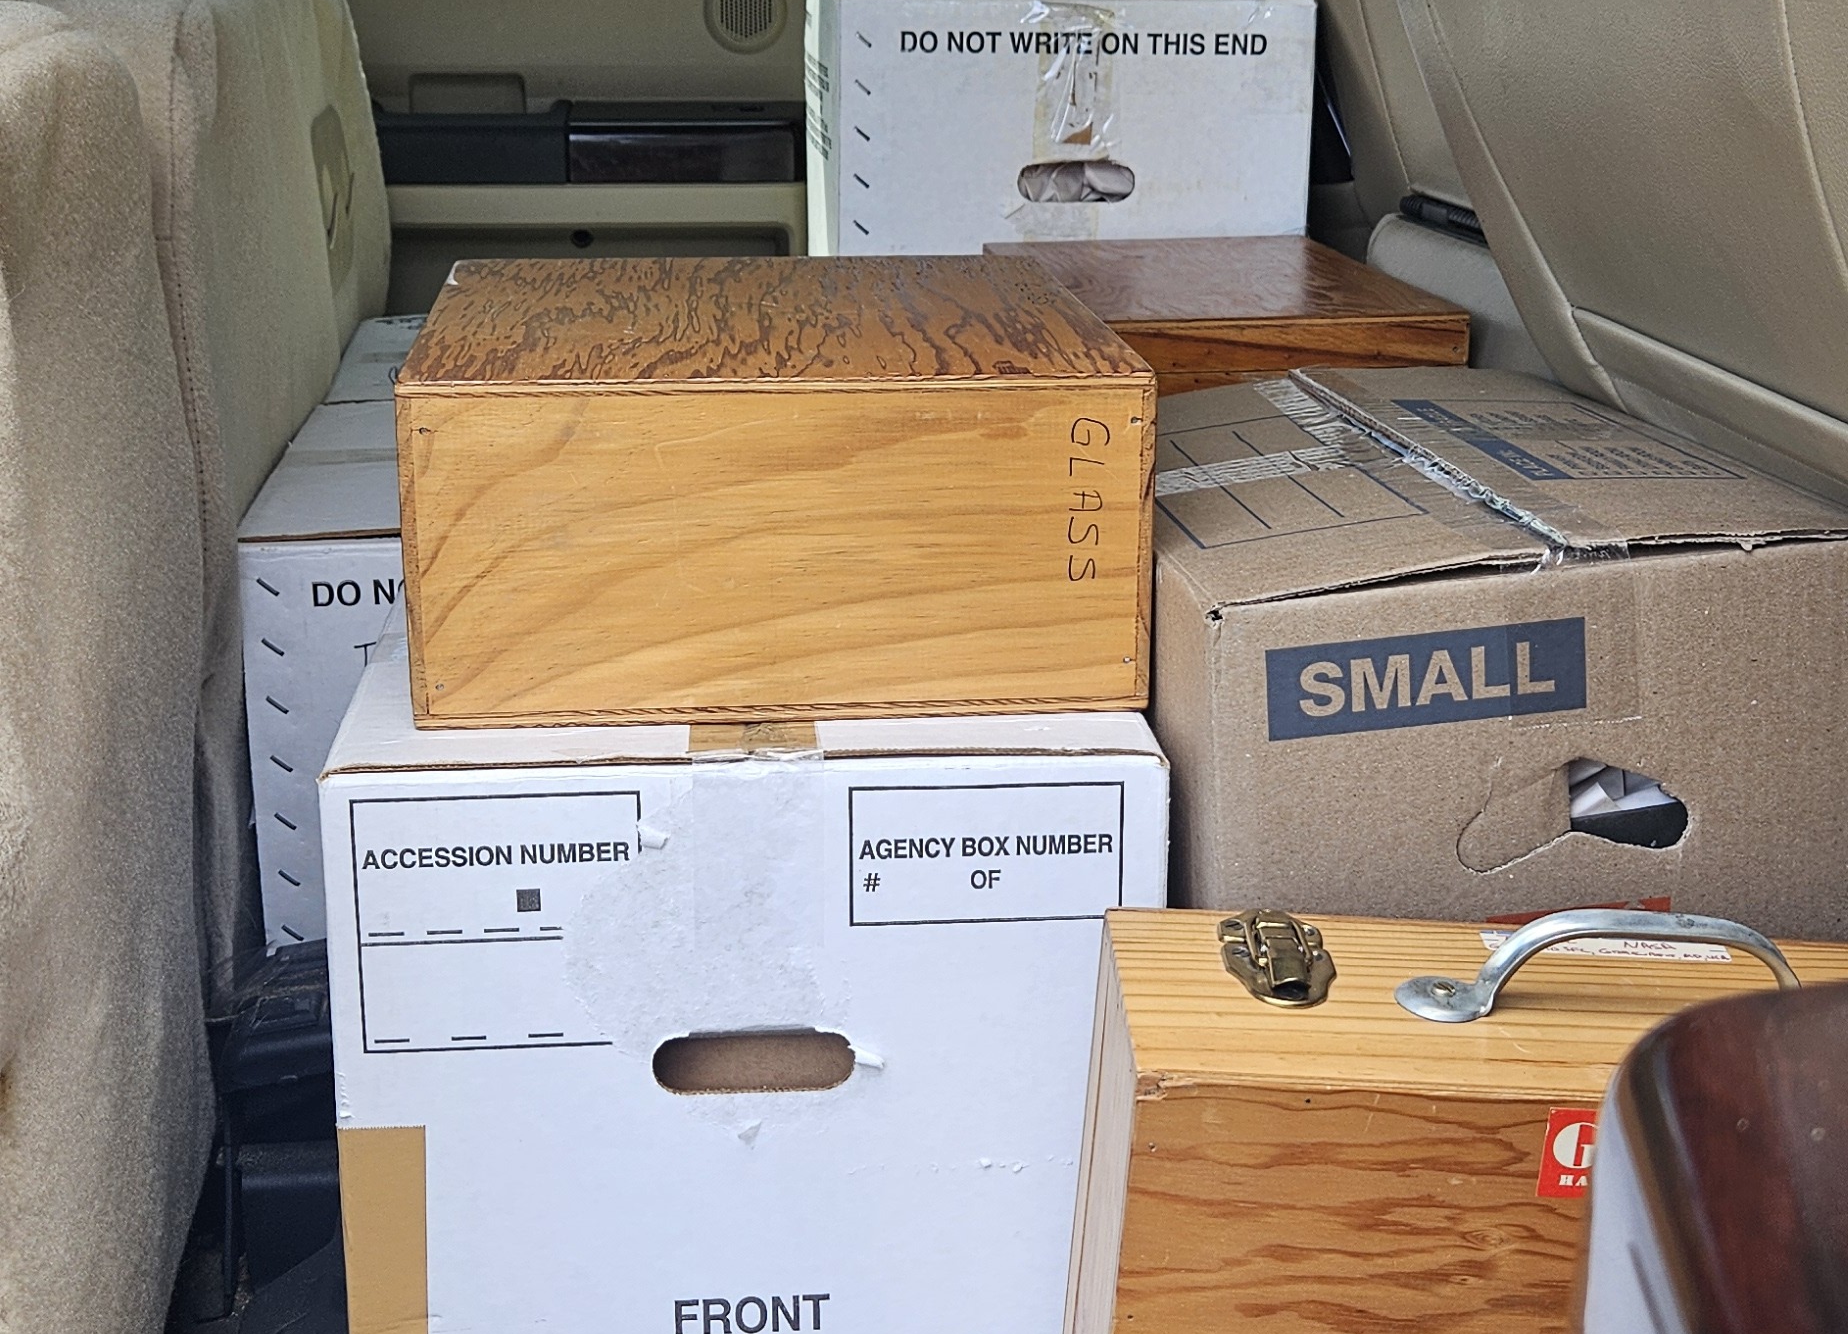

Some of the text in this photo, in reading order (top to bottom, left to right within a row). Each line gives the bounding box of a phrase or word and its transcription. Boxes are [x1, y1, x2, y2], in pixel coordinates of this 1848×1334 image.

[900, 31, 1268, 56] DO NOT WRITE ON THIS END
[1068, 417, 1110, 581] GLASS
[311, 578, 405, 607] DO N
[1299, 641, 1555, 717] SMALL
[361, 841, 630, 870] ACCESSION NUMBER
[858, 833, 1113, 860] AGENCY BOX NUMBER
[862, 869, 1001, 893] # OF
[1623, 940, 1677, 950] NASA
